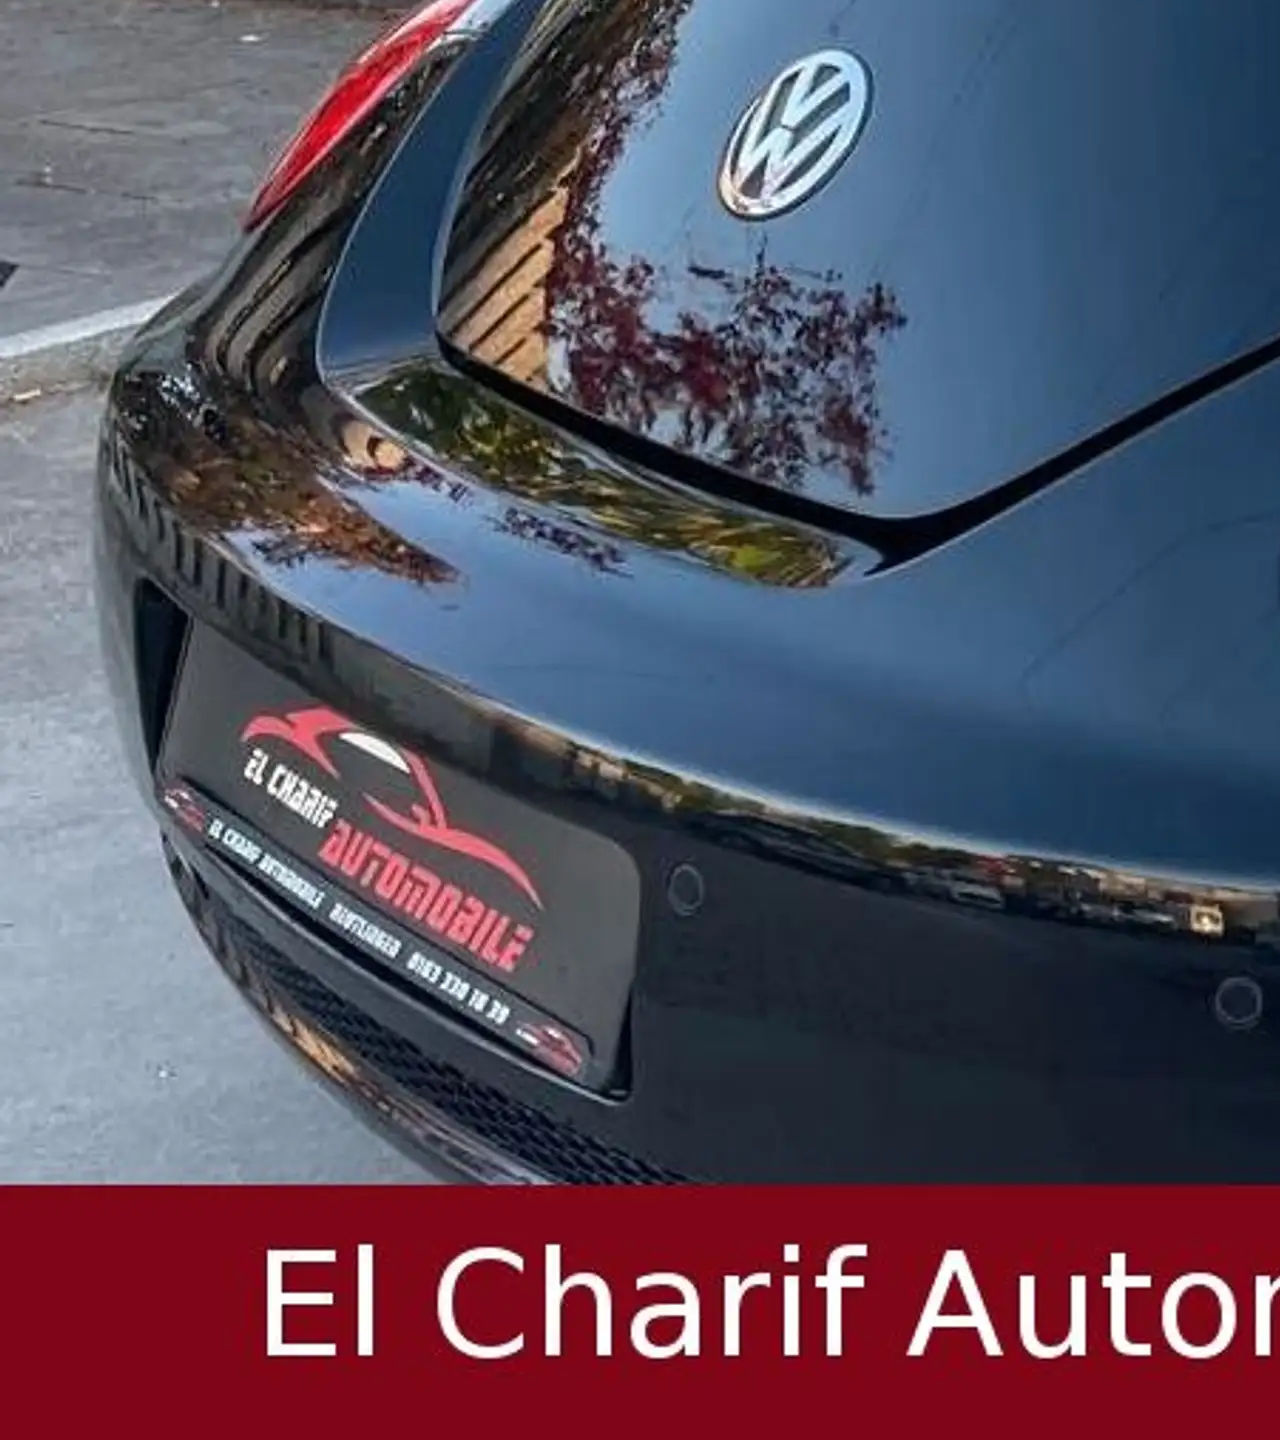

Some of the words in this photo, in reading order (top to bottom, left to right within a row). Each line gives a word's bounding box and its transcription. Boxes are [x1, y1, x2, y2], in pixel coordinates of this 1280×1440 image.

[244, 747, 269, 786] EL
[266, 763, 339, 829] CHARIF
[318, 818, 535, 973] AUTOMOBILE
